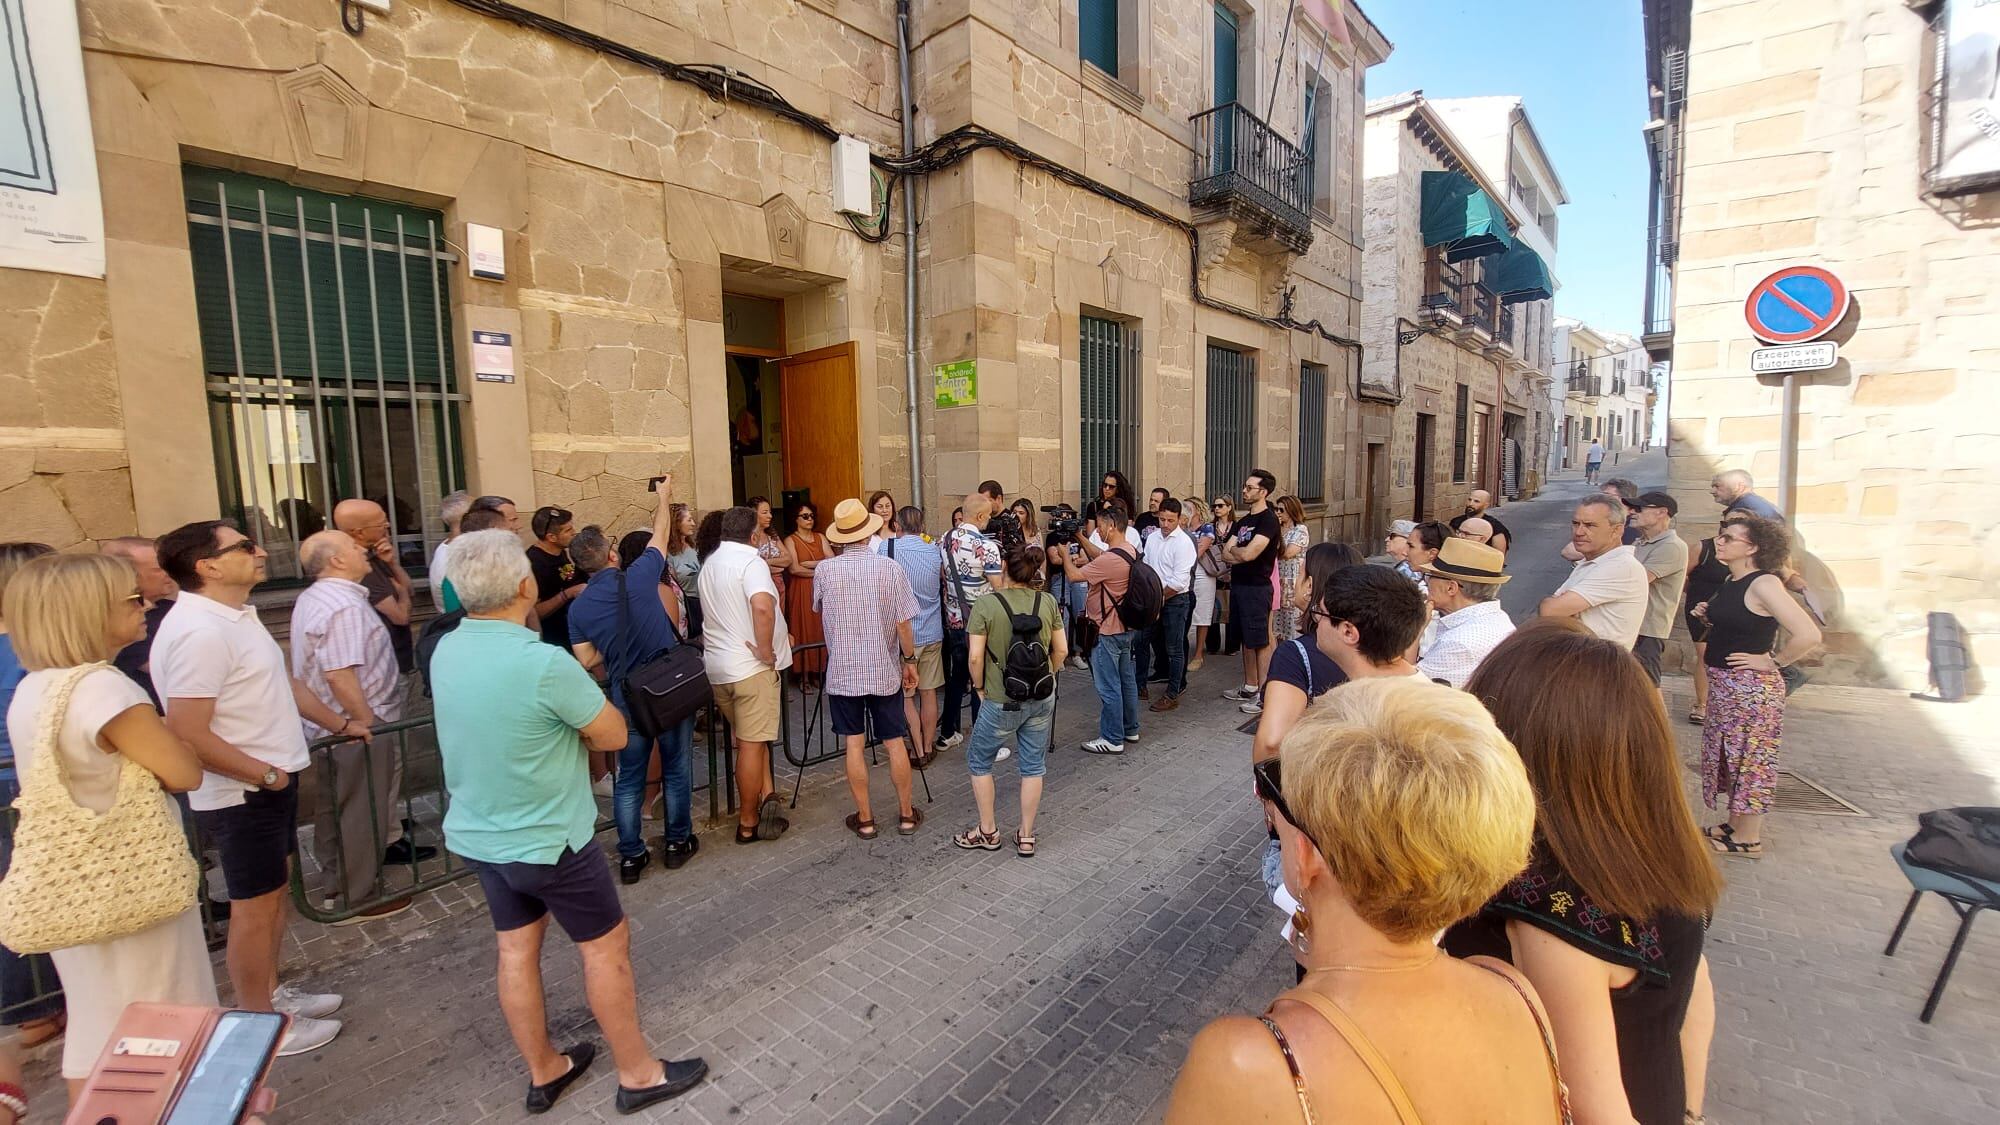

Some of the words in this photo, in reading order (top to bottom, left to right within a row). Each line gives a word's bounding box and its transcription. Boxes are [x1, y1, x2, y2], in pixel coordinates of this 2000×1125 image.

[778, 226, 793, 244] 21
[1756, 350, 1802, 360] Excepto
[1758, 358, 1825, 369] autorizados
